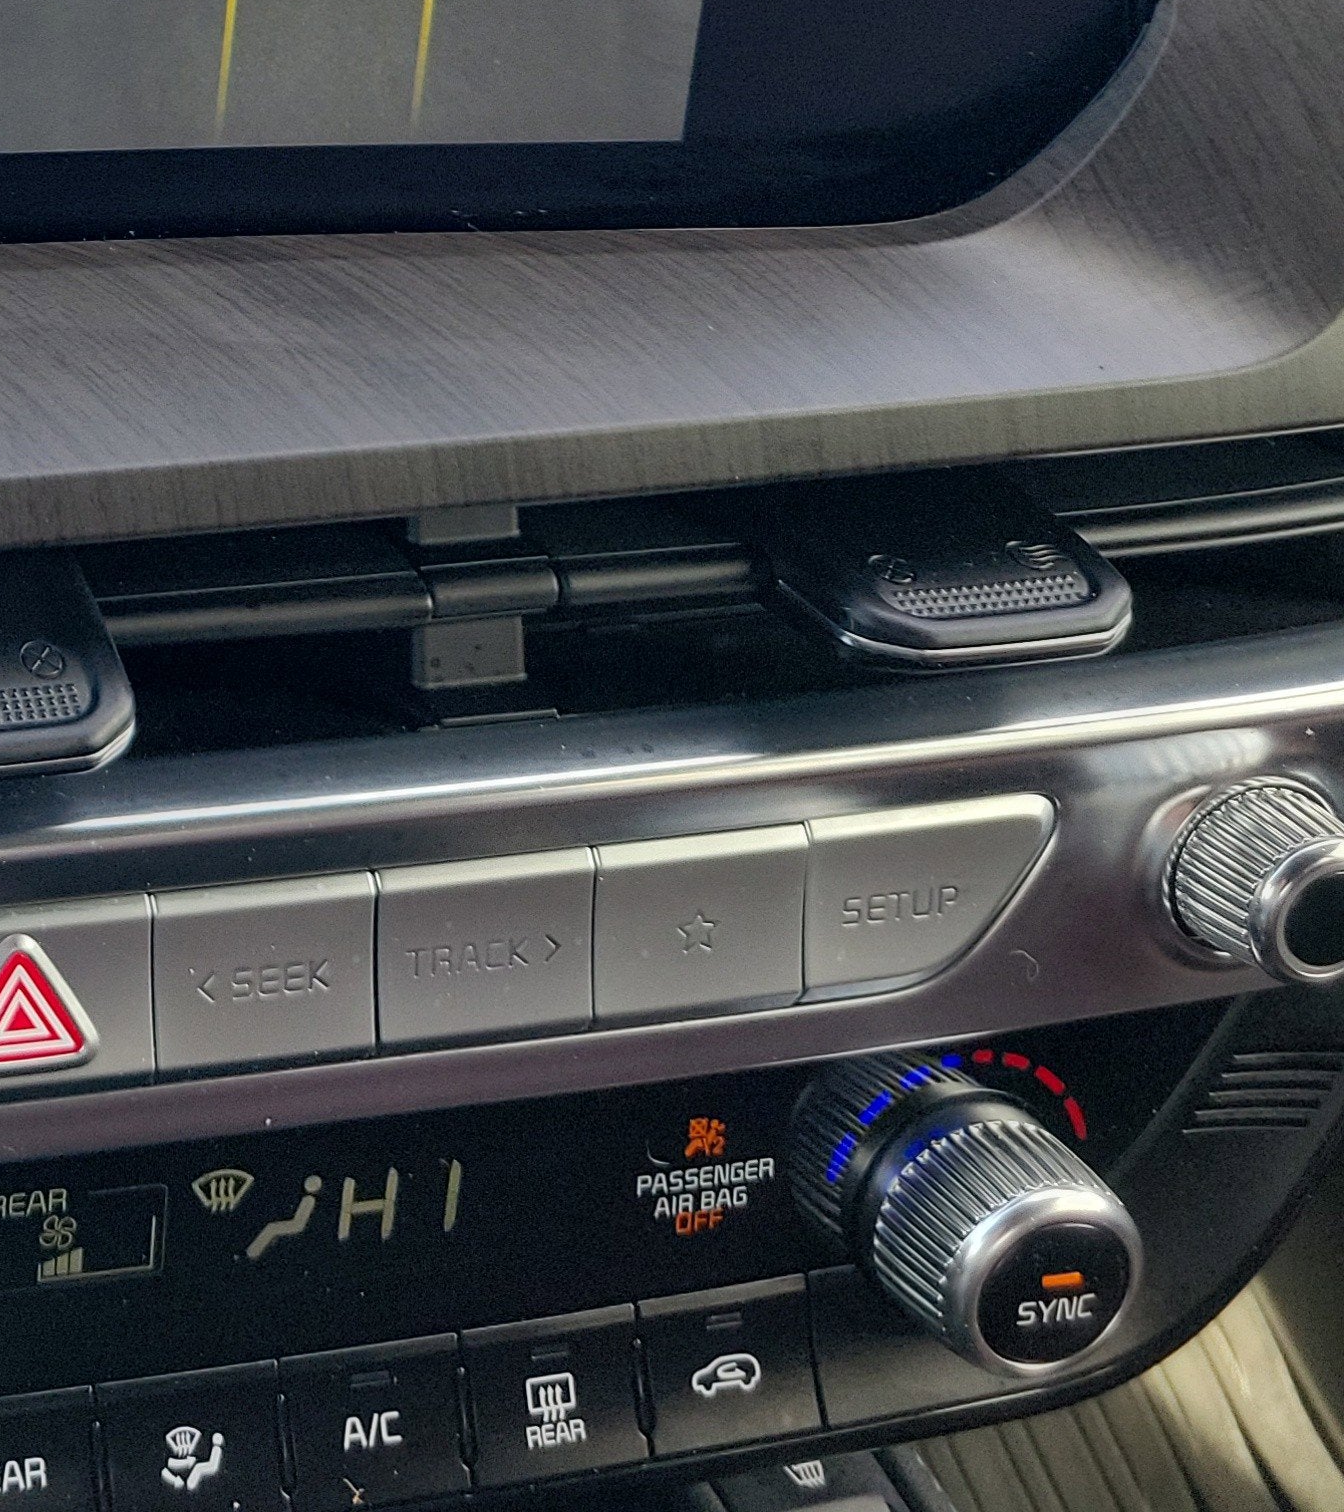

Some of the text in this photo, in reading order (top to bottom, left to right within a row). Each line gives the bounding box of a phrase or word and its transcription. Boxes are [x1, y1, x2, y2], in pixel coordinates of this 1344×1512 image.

[841, 886, 958, 927] SETUP
[406, 937, 529, 978] TRACK
[231, 959, 330, 1001] SEEK
[636, 1157, 775, 1198] PASSENGER
[654, 1186, 748, 1220] AIR BAG
[676, 1208, 725, 1236] OFF
[1016, 1293, 1096, 1326] SYNC
[344, 1410, 403, 1452] A/C
[525, 1418, 587, 1451] REAR
